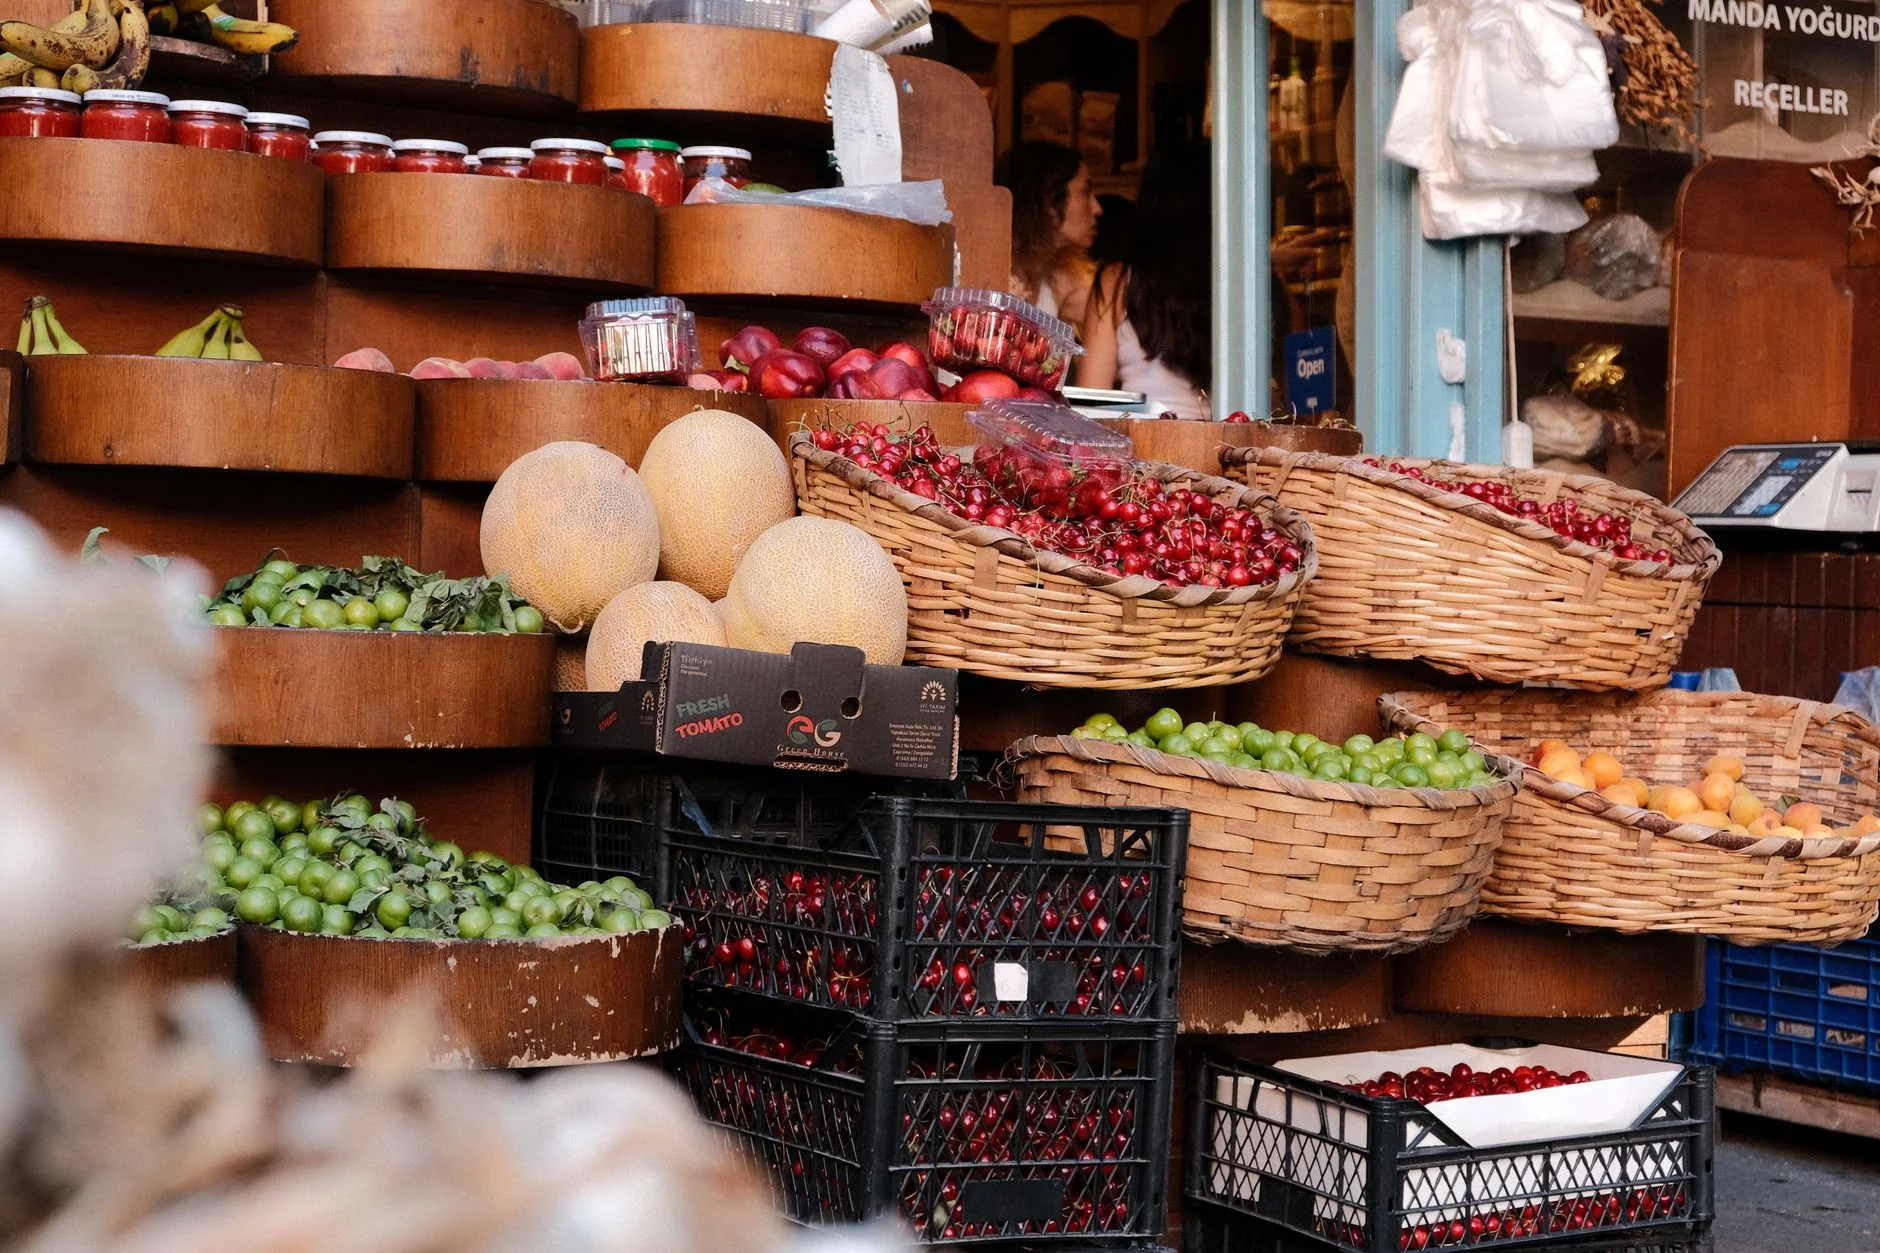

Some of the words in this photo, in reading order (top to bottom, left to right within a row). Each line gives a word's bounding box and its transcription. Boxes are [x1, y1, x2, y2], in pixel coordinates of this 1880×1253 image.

[1688, 0, 1781, 31] MANDA
[1785, 5, 1880, 42] YOĞURD
[1297, 358, 1324, 380] Open
[676, 694, 730, 718] FRESH
[675, 713, 743, 738] TOMATO
[777, 744, 808, 753] Green
[814, 748, 845, 758] House
